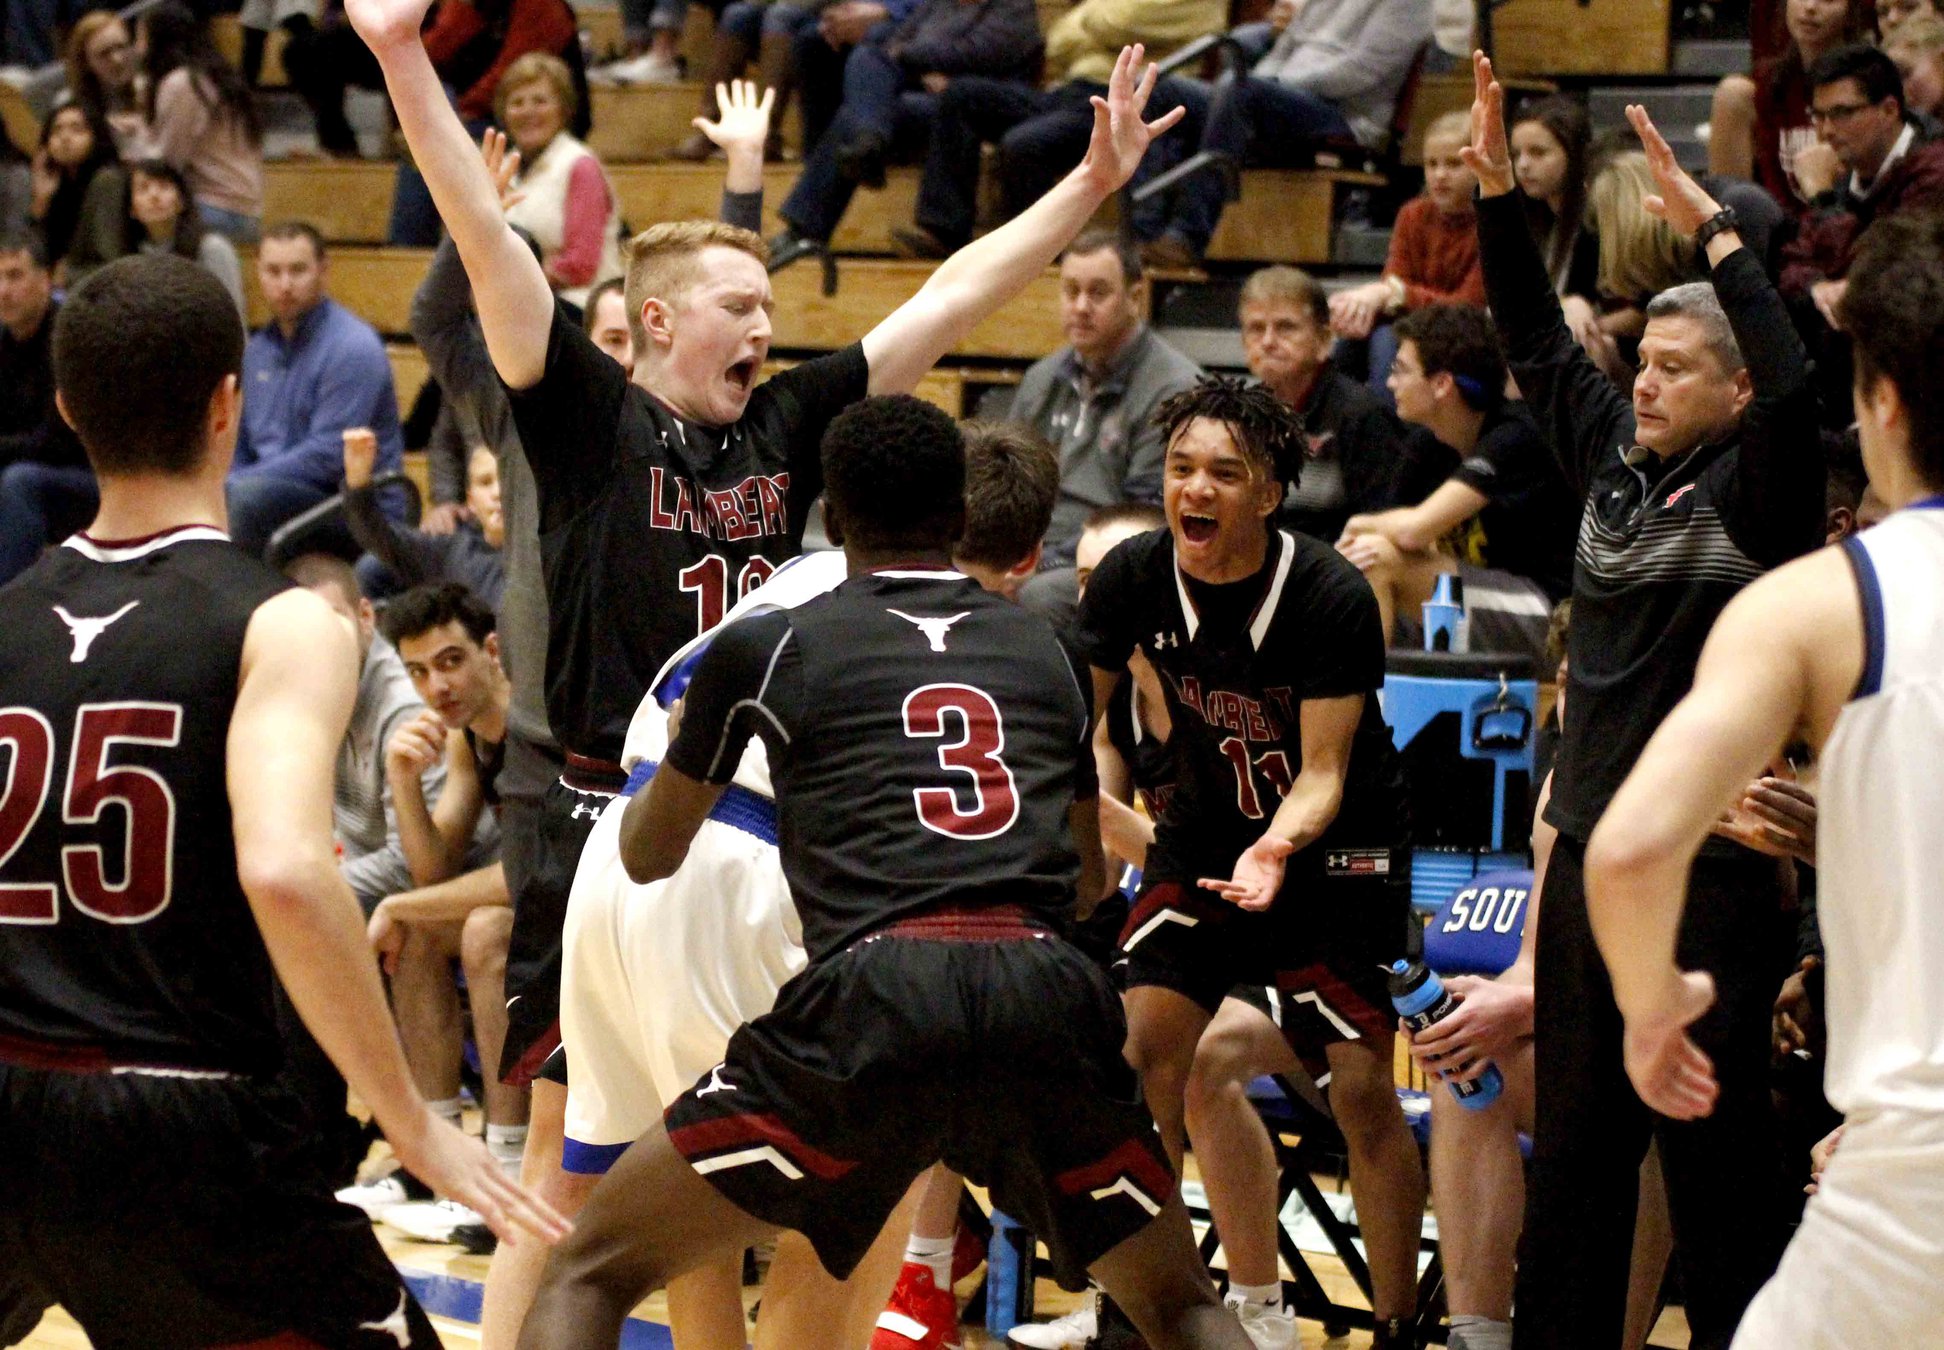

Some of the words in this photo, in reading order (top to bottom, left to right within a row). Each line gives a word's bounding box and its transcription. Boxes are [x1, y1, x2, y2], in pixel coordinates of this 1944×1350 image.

[0, 701, 183, 925] 25
[901, 682, 1020, 841] 3
[1442, 888, 1527, 936] SOU
